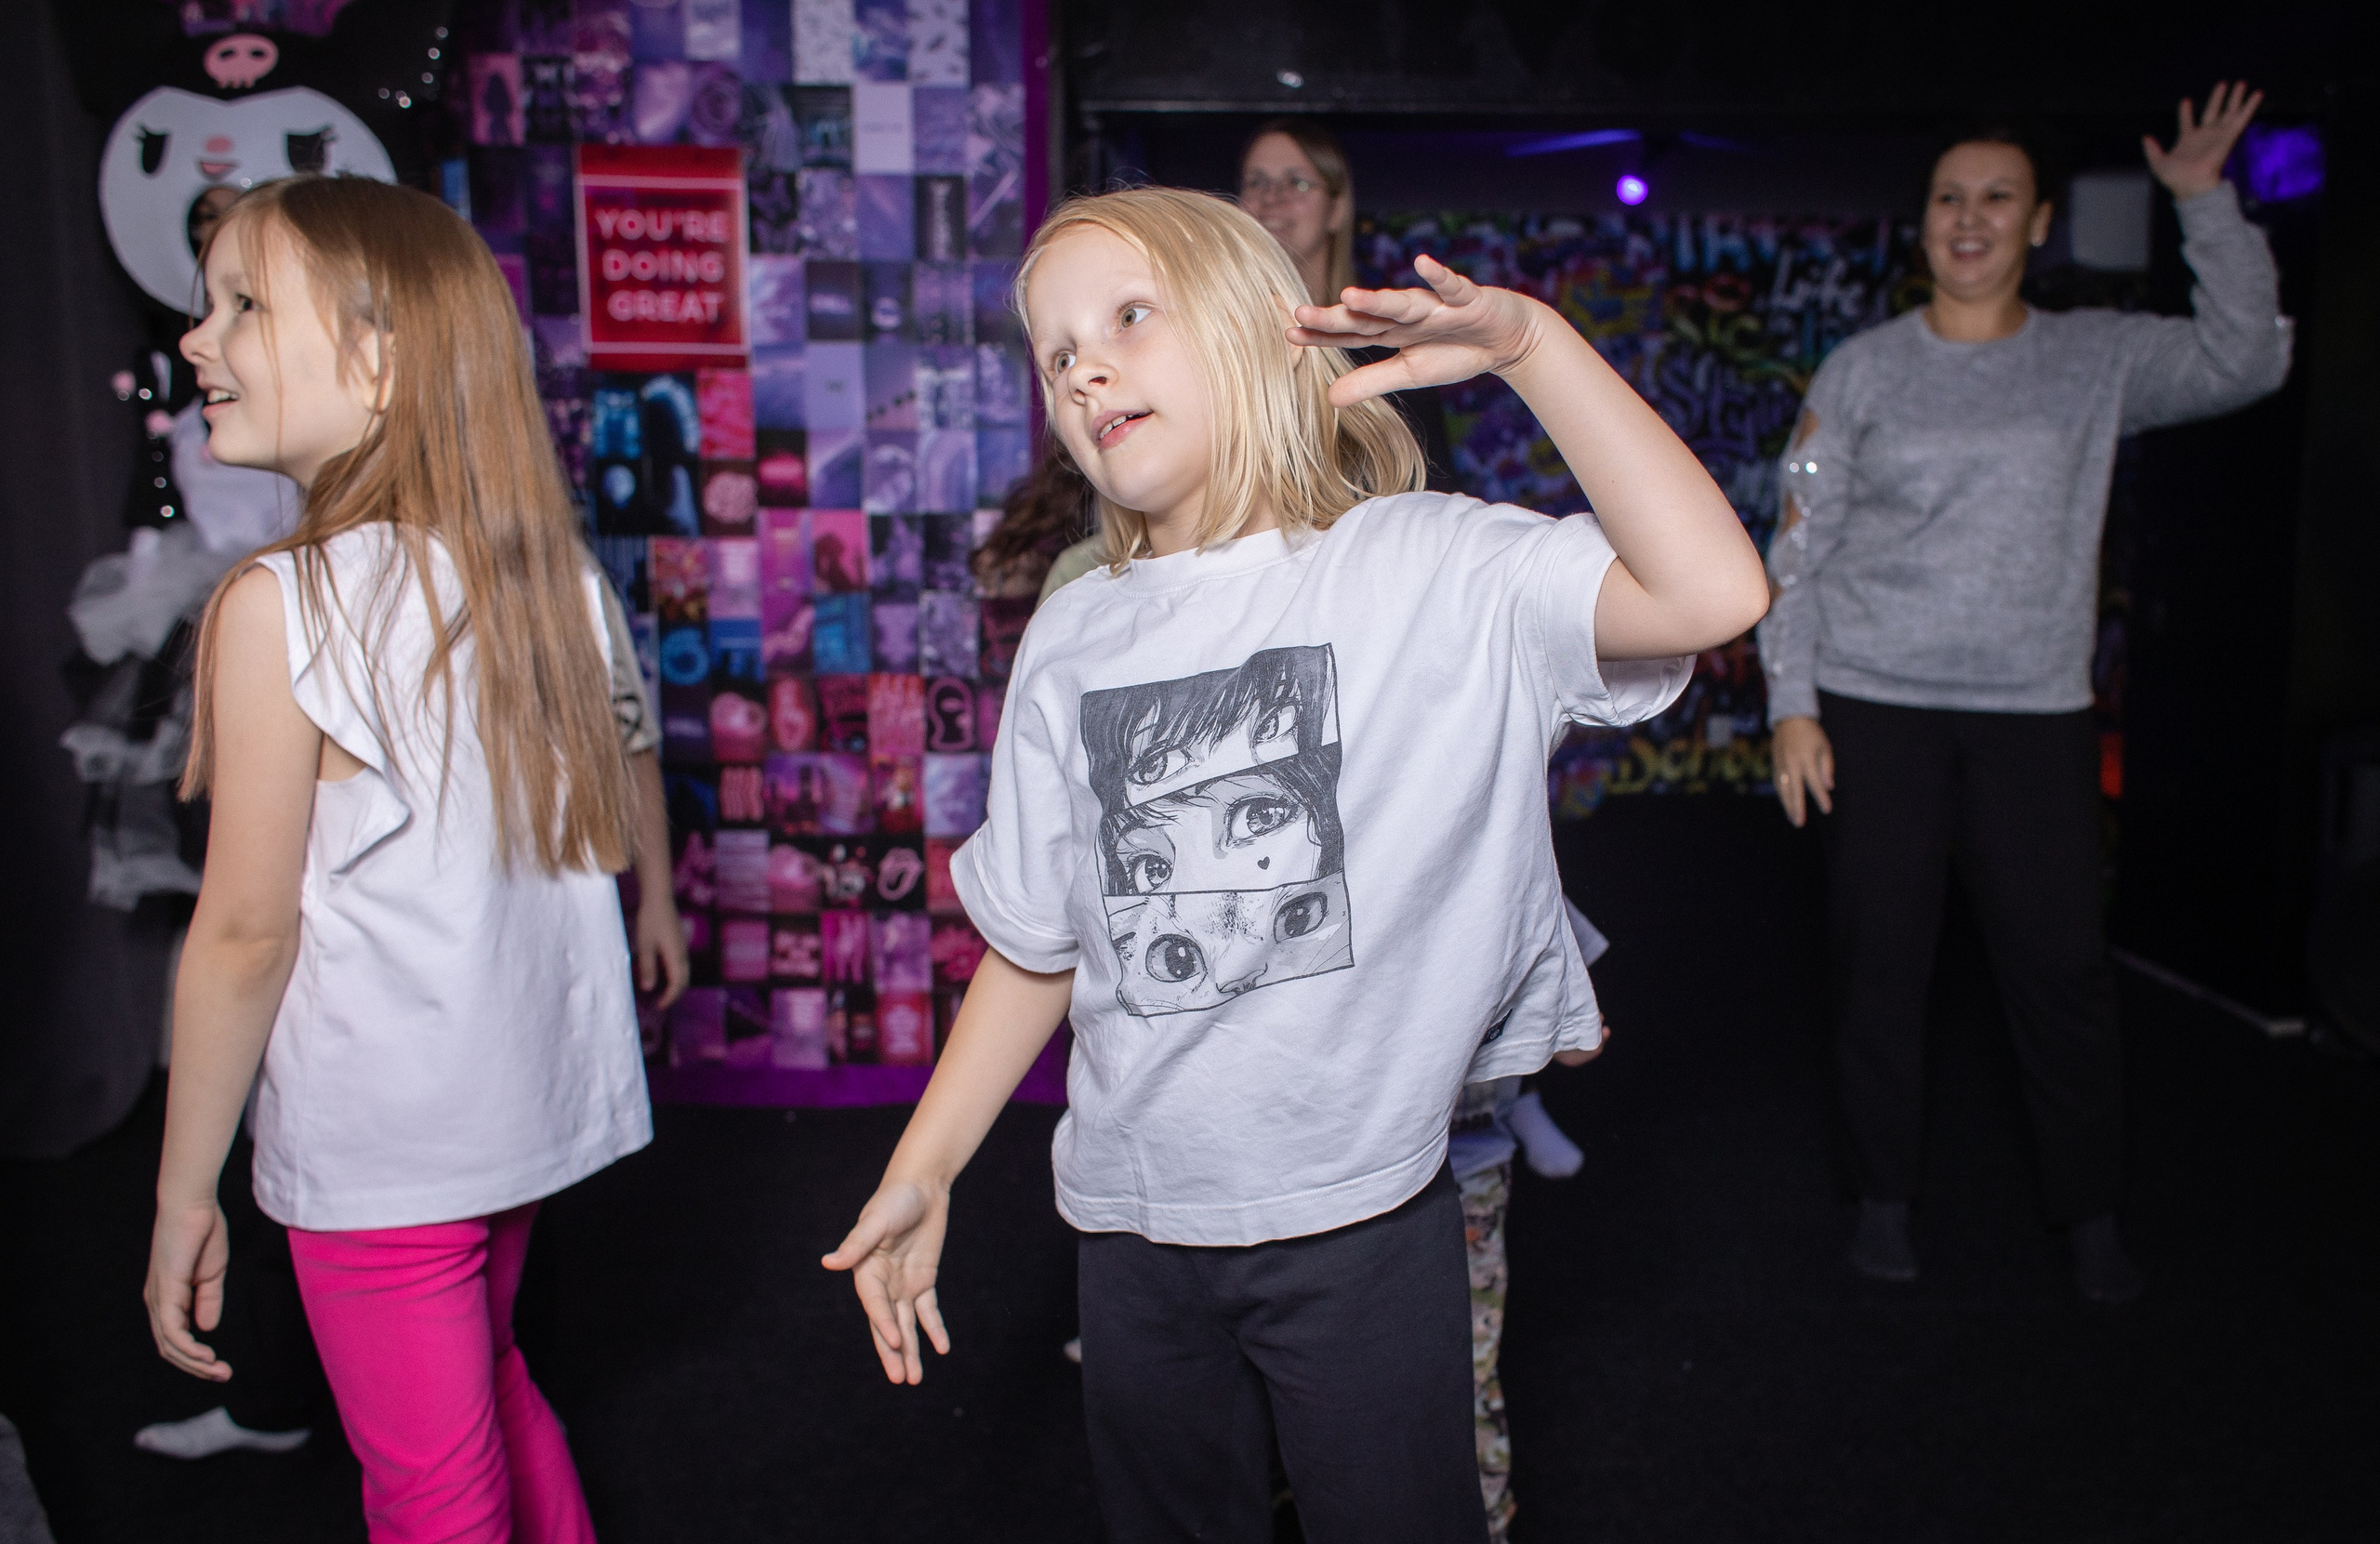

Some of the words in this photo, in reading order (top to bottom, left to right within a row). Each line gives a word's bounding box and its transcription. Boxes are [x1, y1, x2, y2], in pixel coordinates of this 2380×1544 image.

[594, 208, 730, 243] YOU'RE
[602, 250, 725, 283] DOING
[607, 290, 723, 323] GREAT
